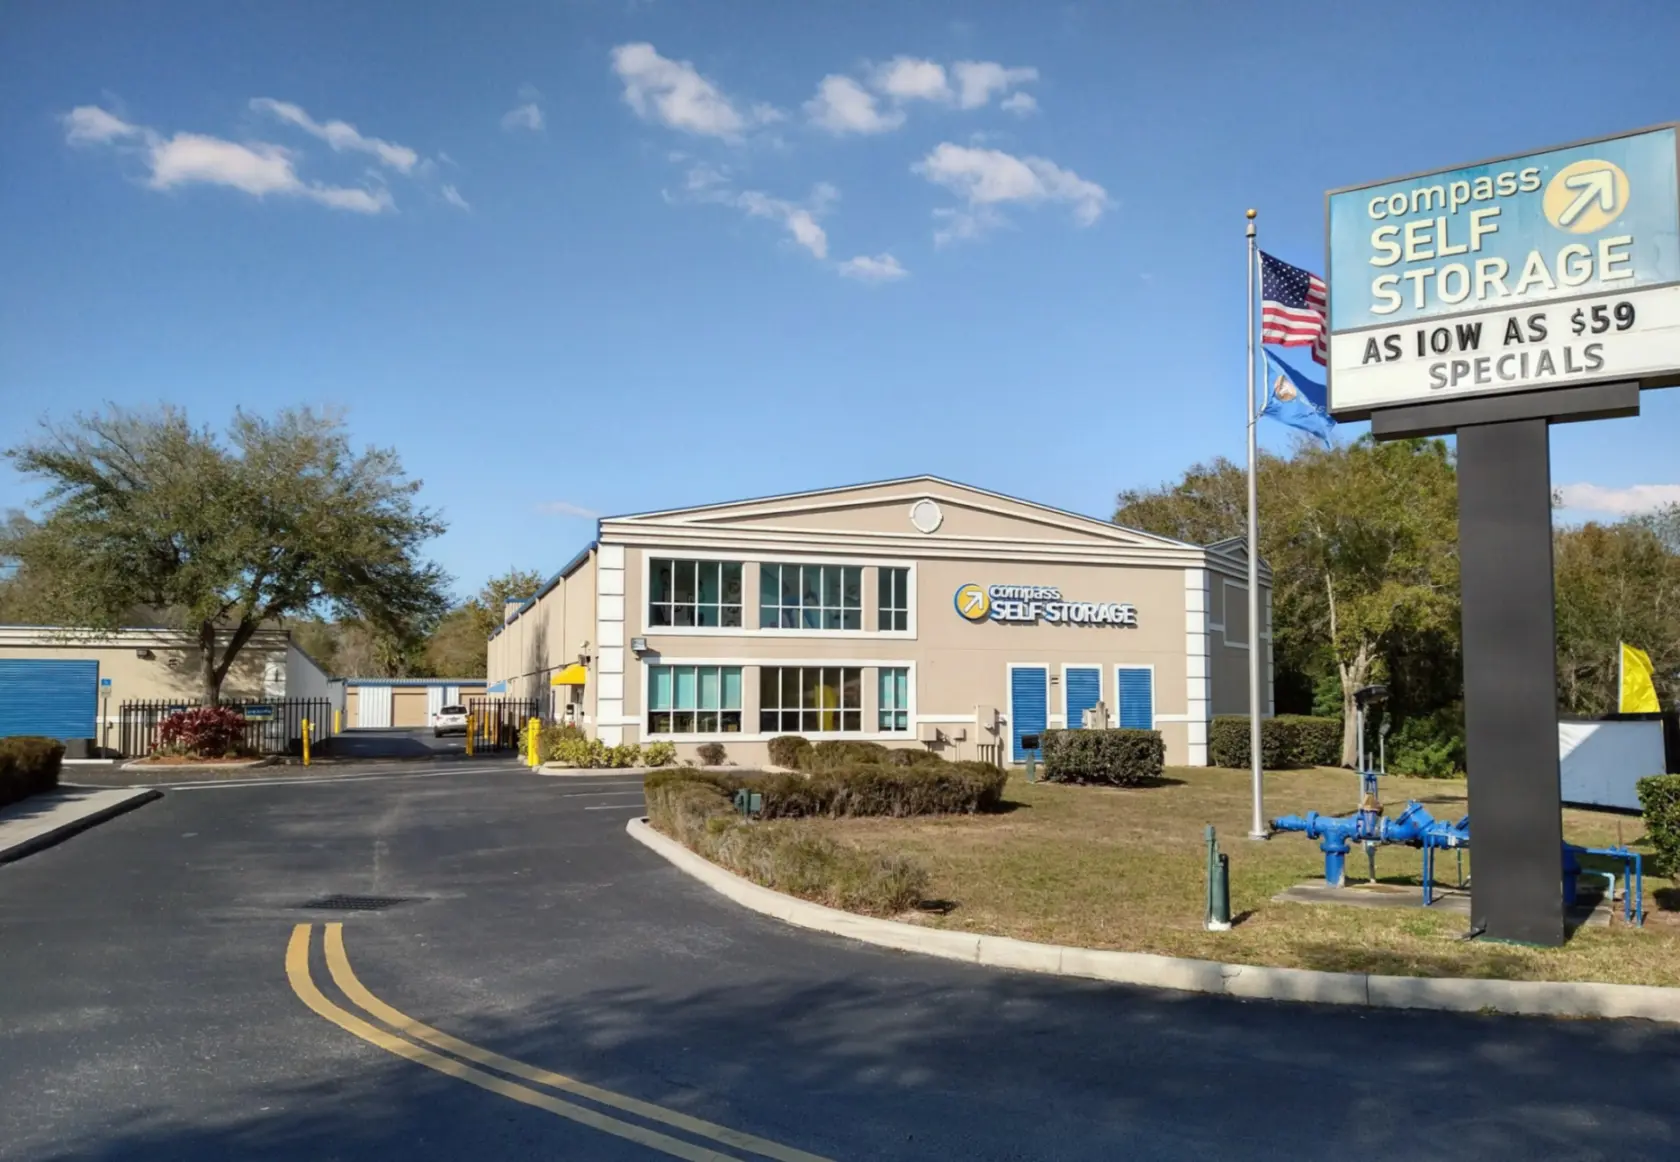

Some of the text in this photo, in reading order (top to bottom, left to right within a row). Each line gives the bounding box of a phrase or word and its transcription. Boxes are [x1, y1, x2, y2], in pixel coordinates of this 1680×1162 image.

[1368, 167, 1542, 220] compass
[1369, 206, 1501, 267] SELF
[1369, 235, 1635, 314] STORAGE
[1362, 334, 1402, 364] AS
[1503, 313, 1548, 346] AS
[1571, 302, 1636, 336] $59
[1429, 343, 1605, 390] SPECIALS
[989, 585, 1061, 601] compass
[990, 601, 1136, 624] SELF STORAGE
